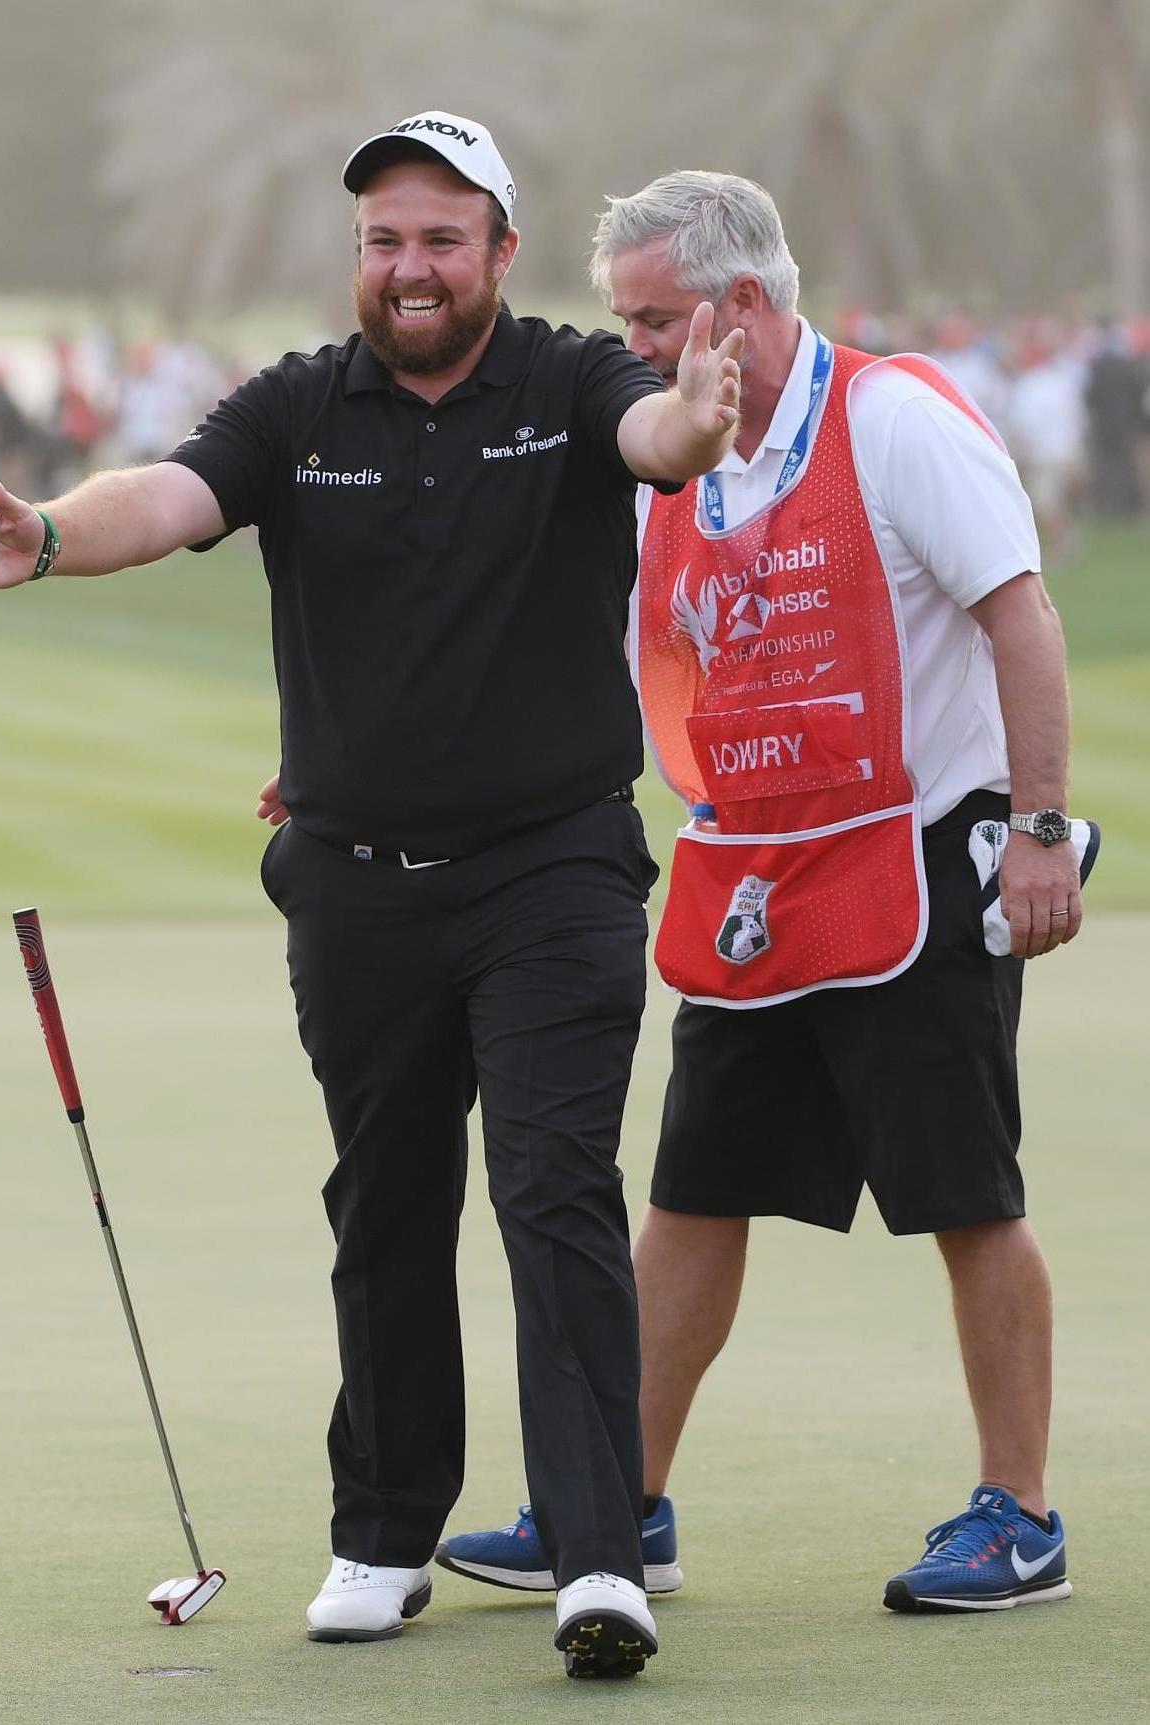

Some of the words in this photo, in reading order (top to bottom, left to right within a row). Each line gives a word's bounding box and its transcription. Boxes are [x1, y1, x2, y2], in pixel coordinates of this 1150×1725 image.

[482, 445, 515, 459] Bank
[515, 441, 529, 456] of
[528, 430, 568, 452] Ireland
[296, 465, 382, 485] immedis
[754, 538, 826, 578] Dhabi
[770, 588, 831, 616] HSBC
[771, 668, 804, 688] EGA
[709, 732, 804, 775] LOWRY
